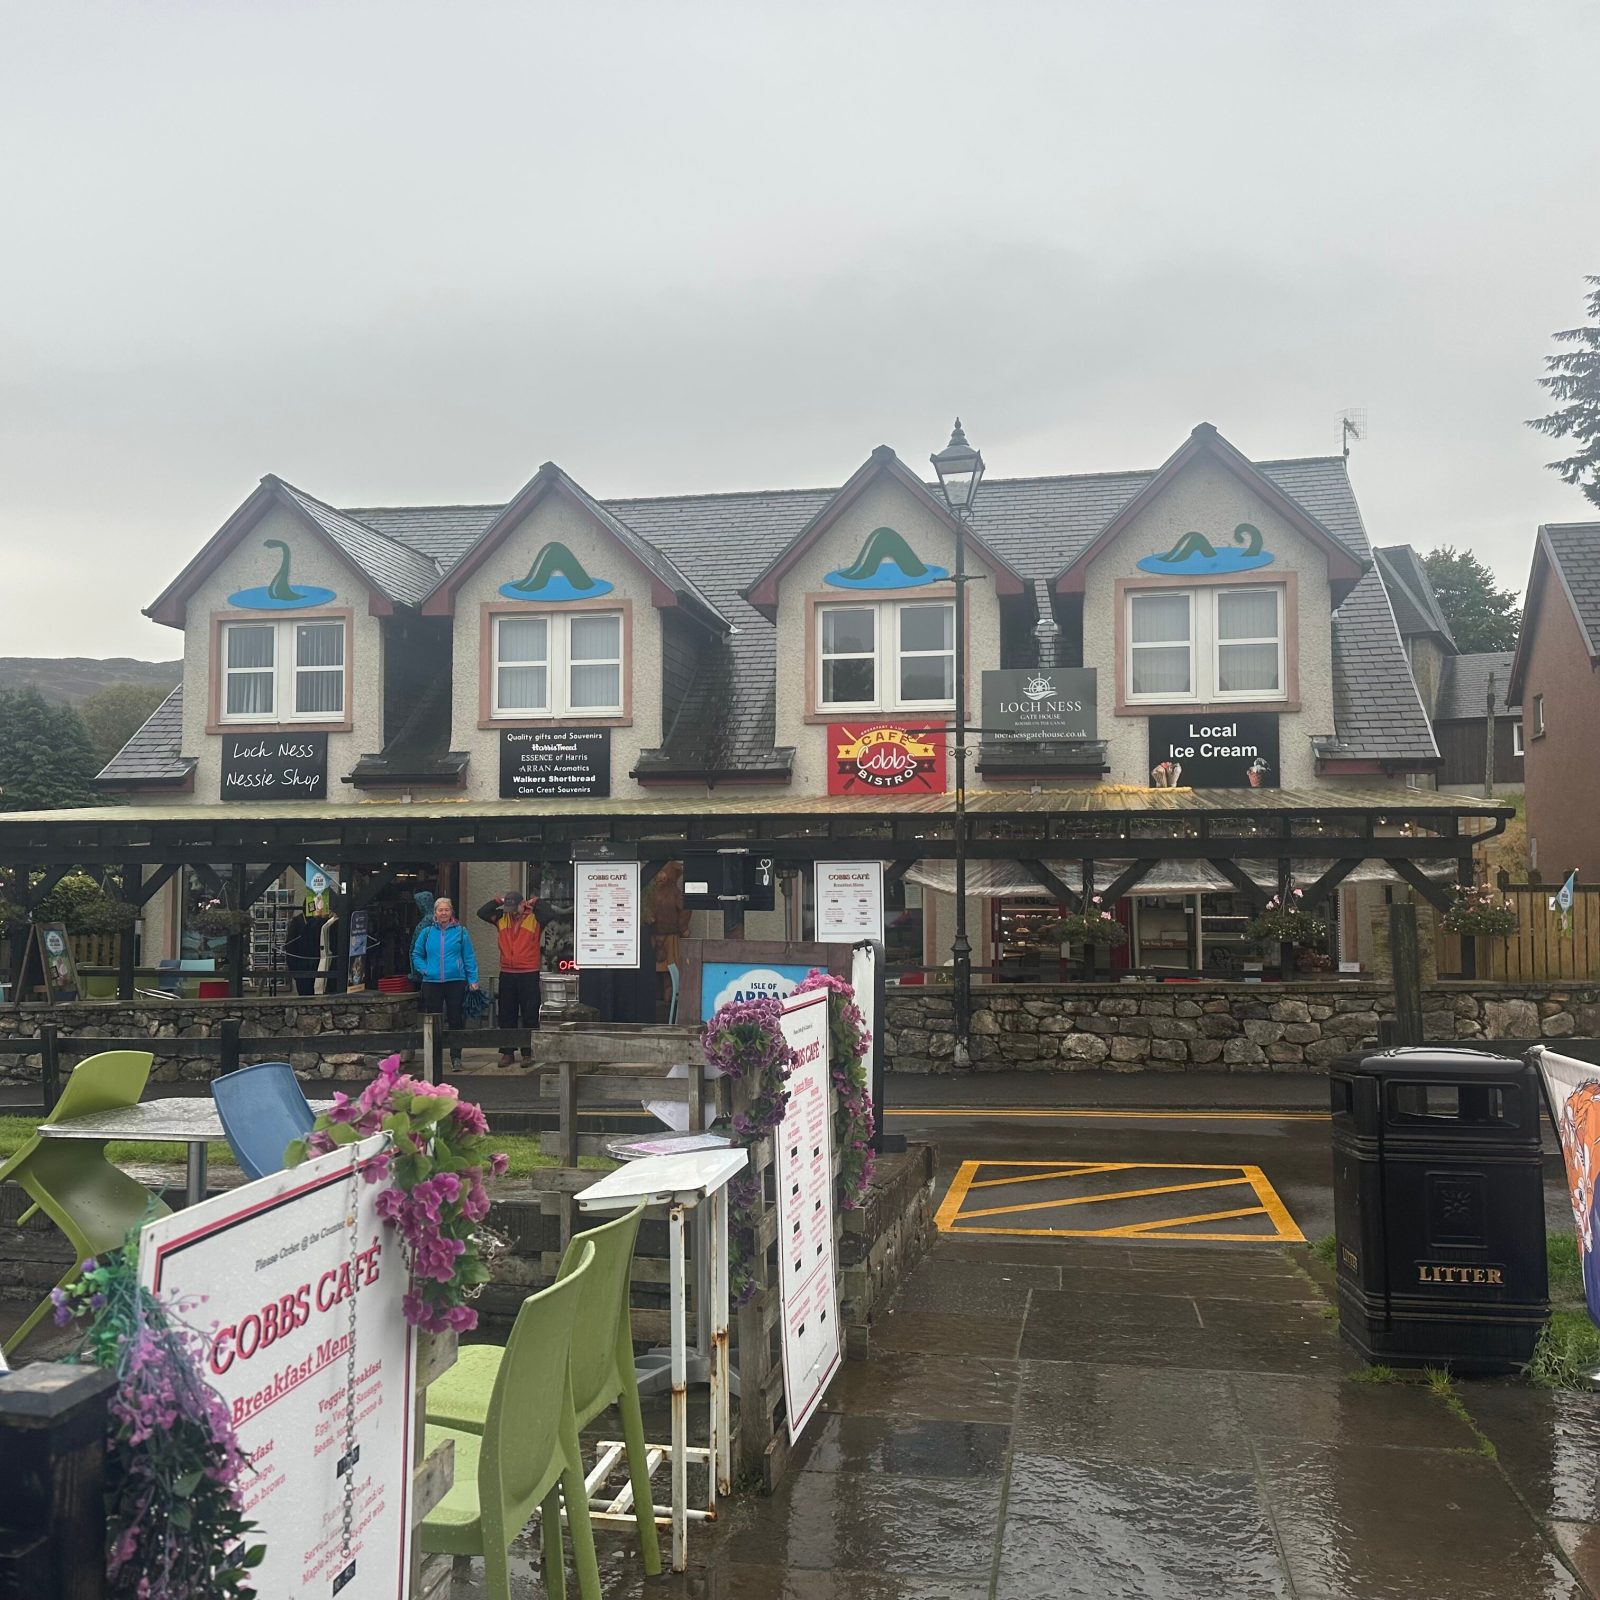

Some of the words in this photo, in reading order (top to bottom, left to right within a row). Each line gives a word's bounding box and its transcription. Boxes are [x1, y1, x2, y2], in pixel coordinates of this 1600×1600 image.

[1000, 702, 1041, 712] LOCH
[1046, 700, 1082, 712] NESS
[506, 733, 532, 742] Quality
[534, 732, 551, 740] gifts
[554, 732, 567, 740] and
[569, 732, 602, 740] Souvenirs
[1189, 722, 1237, 738] Local
[233, 740, 273, 758] Loch
[278, 742, 314, 758] Ness
[521, 754, 553, 762] ESSENCE
[565, 753, 588, 761] Harris
[856, 745, 918, 770] Cobbs
[1169, 744, 1194, 758] Ice
[1200, 743, 1258, 758] Cream
[518, 764, 552, 772] ARRAN
[554, 764, 590, 772] Aromatics
[226, 768, 276, 787] Nessie
[281, 768, 320, 792] Shop
[858, 769, 914, 786] BISTRO
[733, 990, 788, 1003] ARRA
[254, 1250, 278, 1272] Please
[279, 1242, 300, 1258] Order
[300, 1235, 308, 1251] @
[309, 1232, 320, 1244] the
[320, 1220, 346, 1239] Counter
[1418, 1266, 1504, 1284] LITTER
[210, 1283, 310, 1375] COBBS
[316, 1236, 382, 1312] CAFÉ
[232, 1354, 313, 1425] Breakfast
[319, 1387, 346, 1413] Veggie
[352, 1358, 382, 1388] reakfast
[302, 1558, 324, 1585] Maple
[372, 1500, 385, 1518] with
